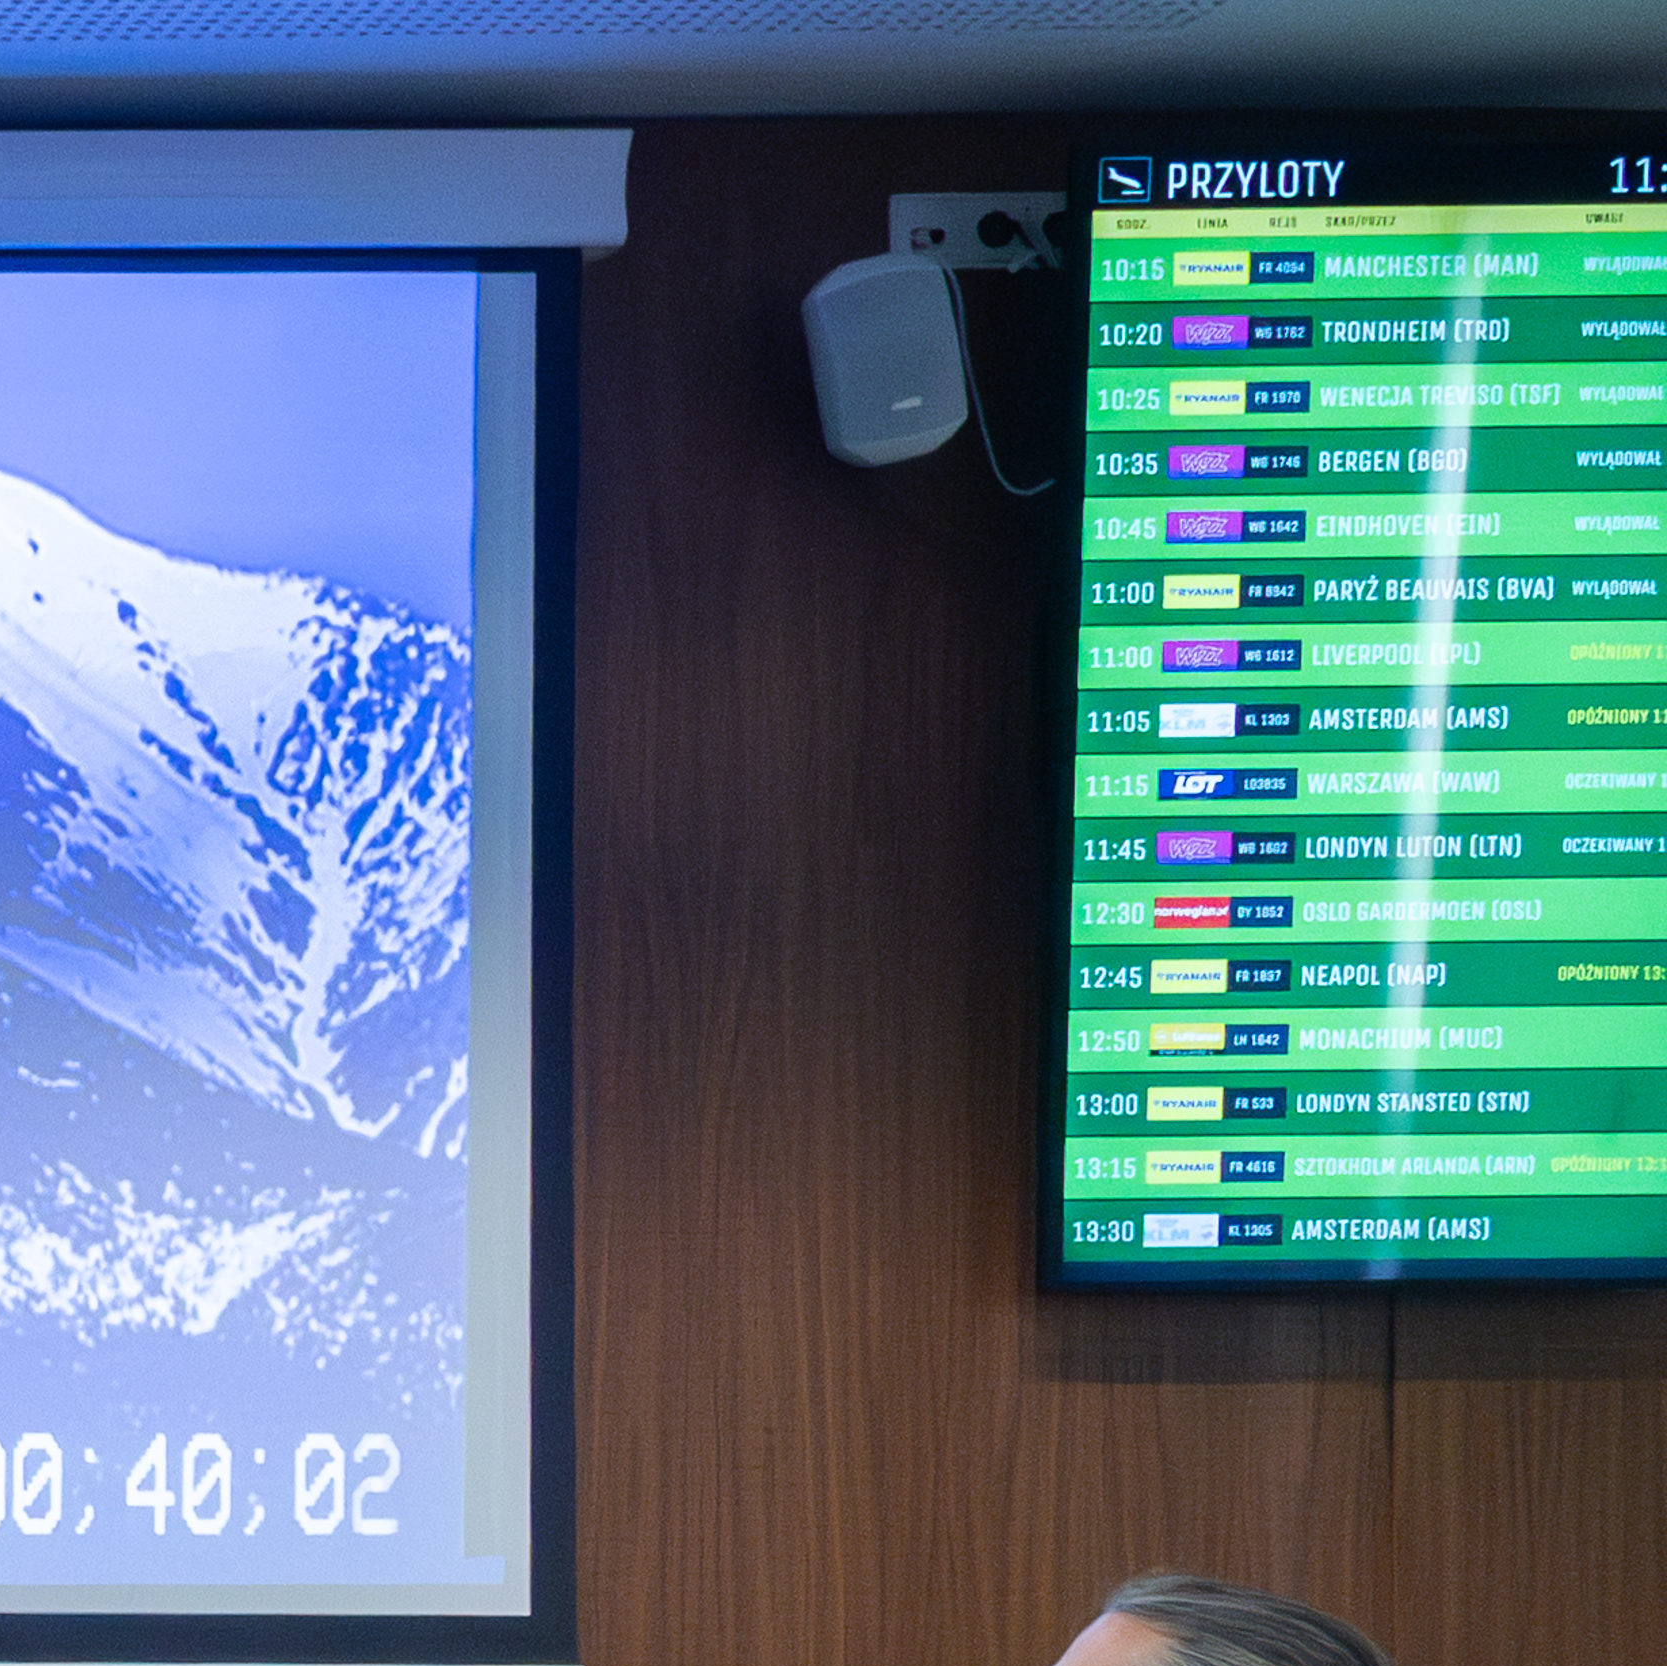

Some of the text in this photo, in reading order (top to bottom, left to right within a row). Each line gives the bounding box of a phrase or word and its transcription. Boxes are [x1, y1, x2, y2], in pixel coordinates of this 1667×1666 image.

[1167, 160, 1345, 199] PRZYLOTY
[1101, 257, 1165, 282] 10:15
[1258, 261, 1274, 275] FR
[1324, 254, 1467, 279] MANCHESTER
[1473, 252, 1539, 278] (MAN)
[1099, 322, 1163, 346] 10:20
[1321, 320, 1446, 344] TRONDHEIM
[1454, 317, 1510, 343] (TRD)
[1097, 387, 1161, 412] 10:25
[1254, 391, 1270, 406] FR
[1319, 385, 1414, 408] WENECJA
[1420, 383, 1503, 406] TREVISO
[1510, 382, 1562, 407] (TSF)
[1095, 452, 1159, 476] 10:35
[1317, 450, 1401, 474] BERGEN
[1407, 448, 1468, 474] (BGO)
[1575, 450, 1662, 471] WYLĄDOWAŁ
[1093, 517, 1158, 541] 10:45
[1316, 513, 1440, 538] EINDHOVEN
[1445, 512, 1501, 537] (EIN)
[1090, 581, 1156, 605] 11:00
[1247, 584, 1263, 598] FR
[1313, 574, 1379, 602] PARYŻ
[1385, 577, 1490, 602] BEAUVAIS
[1496, 575, 1556, 602] (BVA)
[1571, 579, 1658, 600] WYLĄDOWAŁ
[1089, 646, 1153, 670] 11:00
[1311, 642, 1425, 667] LIVERPOOL
[1430, 640, 1481, 666] (LPL)
[1086, 710, 1151, 734] 11:05
[1308, 707, 1439, 732] AMSTERDAM
[1445, 705, 1510, 731] (AMS)
[1567, 705, 1650, 726] OPÓŹNIONY
[1085, 774, 1149, 798] 11:15
[1173, 774, 1224, 794] LOT
[1307, 771, 1425, 795] WARSZAWA
[1432, 769, 1501, 794] (WAW)
[1564, 772, 1658, 790] OCZEKIWANY
[1083, 837, 1147, 861] 11:45
[1305, 835, 1389, 860] LONDYN
[1396, 834, 1462, 859] LUTON
[1469, 832, 1524, 859] (LTN)
[1562, 836, 1655, 855] OCZEKIWANY
[1081, 901, 1145, 926] 12:30
[1302, 900, 1352, 923] OSLO
[1356, 899, 1486, 923] GARDERMOEN
[1491, 898, 1543, 922] (OSL)
[1079, 965, 1143, 989] 12:45
[1235, 969, 1251, 983] FR
[1300, 964, 1380, 987] NEAPOL
[1387, 962, 1447, 987] (NAP)
[1557, 963, 1640, 982] OPÓŹNIONY
[1077, 1029, 1141, 1053] 12:50
[1299, 1027, 1432, 1051] MONACHIUM
[1439, 1025, 1503, 1050] (MUC)
[1075, 1093, 1139, 1116] 13:00
[1235, 1096, 1251, 1110] FR
[1295, 1092, 1371, 1113] LONDYN
[1376, 1091, 1472, 1113] STANSTED
[1477, 1089, 1530, 1113] (STN)
[1073, 1156, 1137, 1180] 13:15
[1229, 1160, 1245, 1174] FR
[1294, 1156, 1396, 1177] SZTOKHOLM
[1401, 1156, 1481, 1176] ARLANDA
[1485, 1154, 1536, 1176] (ARN)
[1072, 1220, 1135, 1243] 13:30
[1291, 1218, 1420, 1241] AMSTERDAM
[1427, 1216, 1492, 1241] (AMS)
